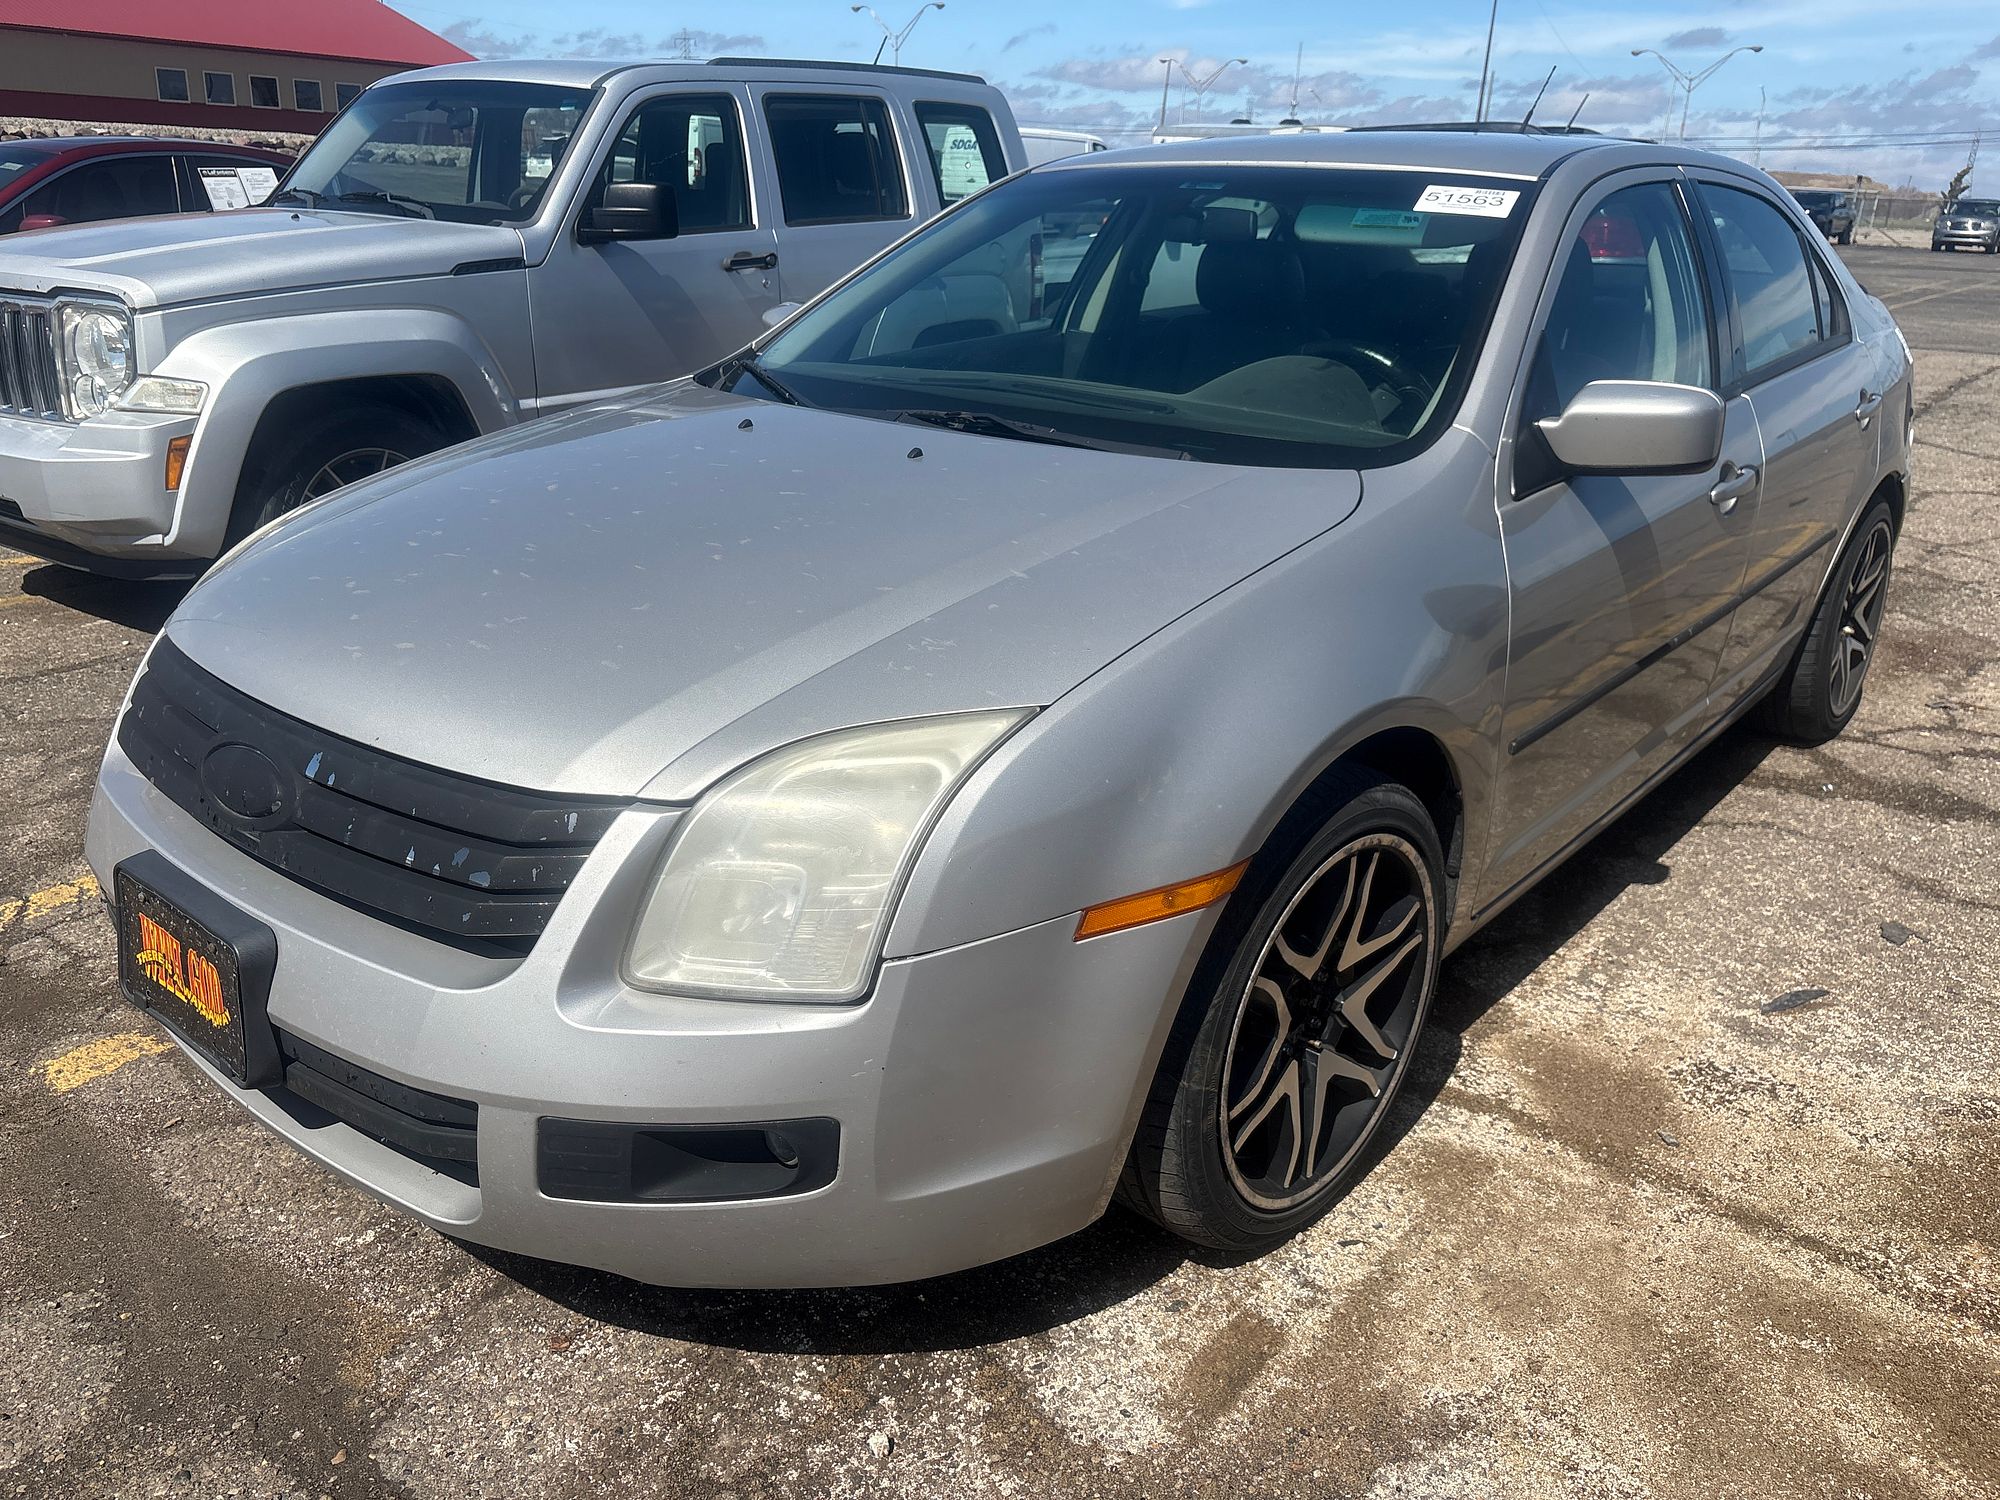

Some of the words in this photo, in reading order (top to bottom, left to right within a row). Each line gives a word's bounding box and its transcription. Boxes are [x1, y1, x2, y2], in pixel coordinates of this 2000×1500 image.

[1424, 191, 1504, 206] 51563
[136, 950, 165, 966] THERE
[187, 948, 224, 1013] GOD
